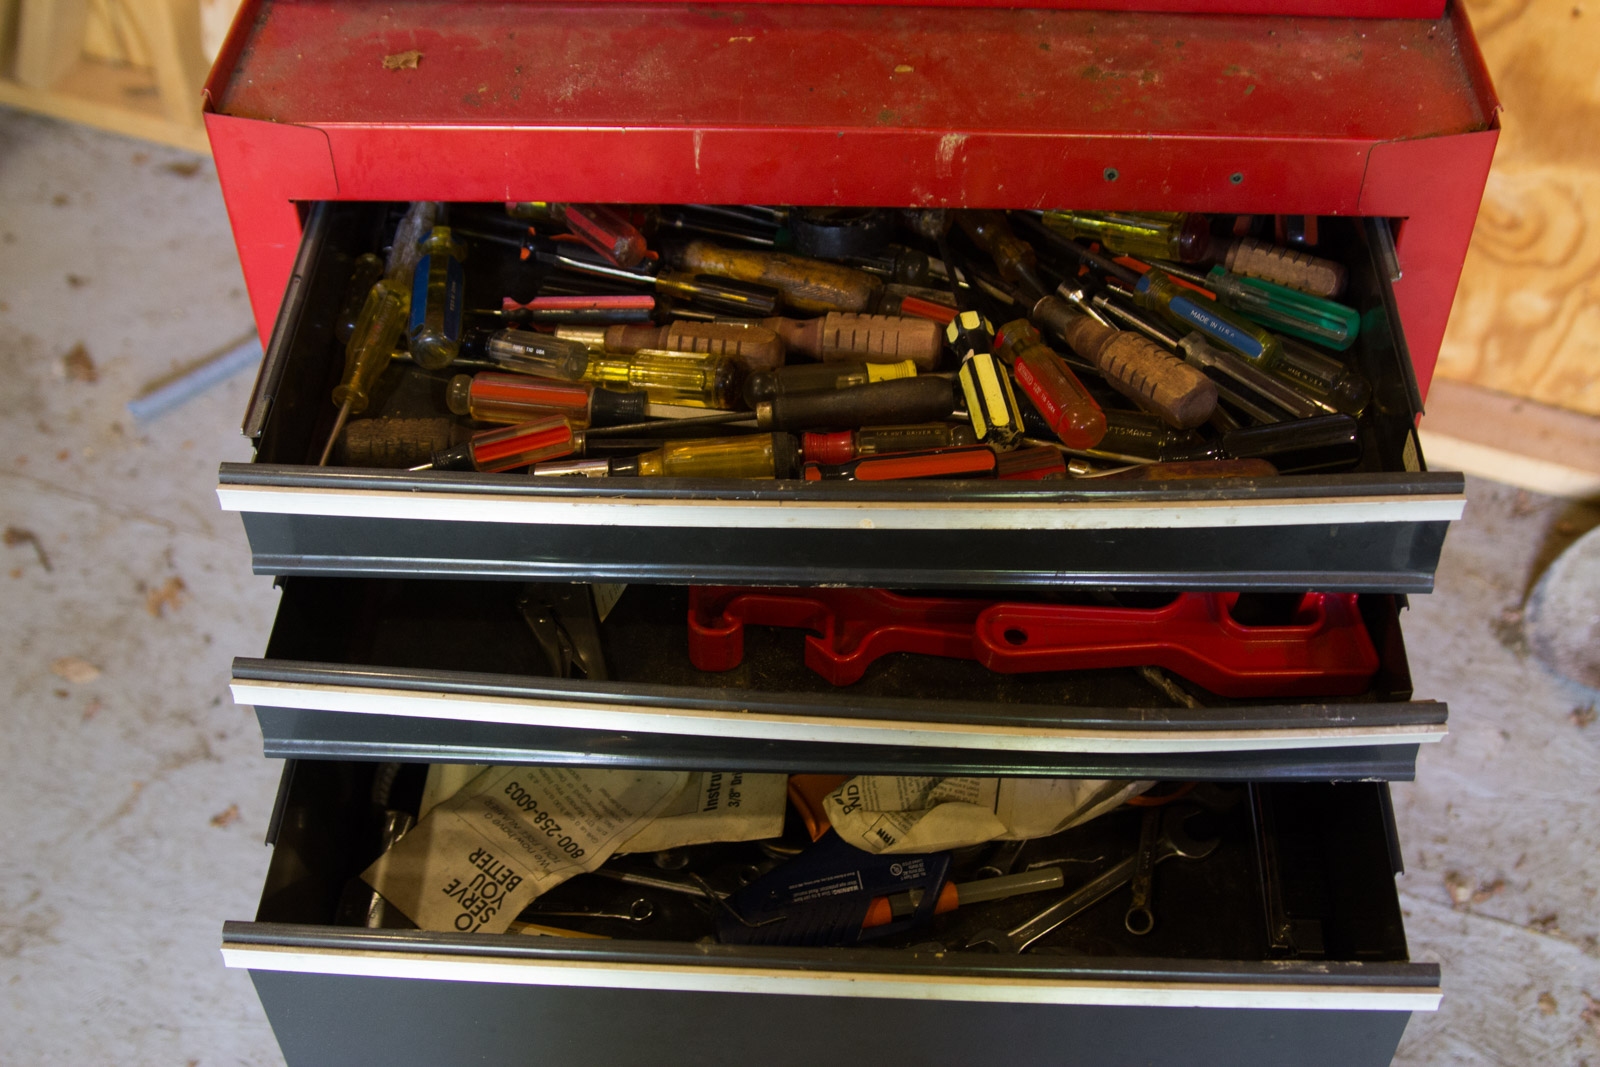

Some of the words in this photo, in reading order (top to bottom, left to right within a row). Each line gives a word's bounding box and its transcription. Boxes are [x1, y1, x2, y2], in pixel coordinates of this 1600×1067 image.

[1189, 309, 1210, 325] MADE
[1209, 320, 1218, 329] IN
[703, 771, 721, 811] Instru
[483, 796, 520, 829] NUMBER
[483, 811, 493, 820] a
[491, 817, 517, 840] have
[503, 779, 585, 859] 800-258-6003
[514, 835, 535, 854] now
[534, 852, 549, 869] We
[467, 846, 522, 891] BETTER
[442, 877, 495, 923] SERVE
[468, 872, 505, 910] YOU
